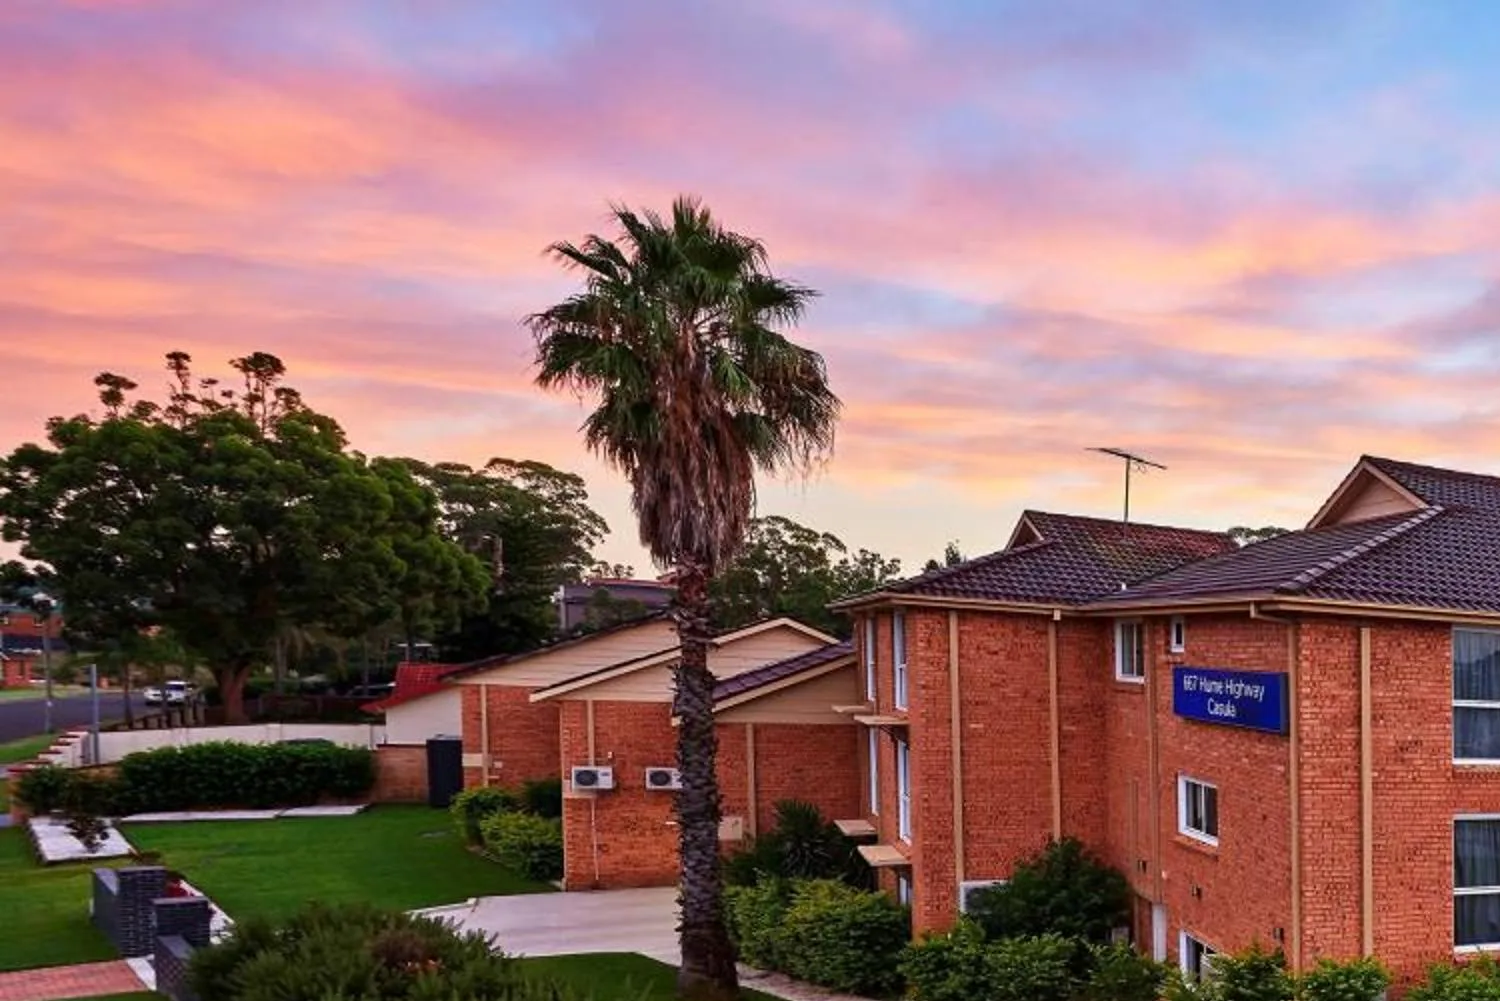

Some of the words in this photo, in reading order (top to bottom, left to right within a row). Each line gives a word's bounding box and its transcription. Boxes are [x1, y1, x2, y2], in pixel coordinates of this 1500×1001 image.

[1200, 677, 1223, 694] Hume
[1226, 679, 1265, 702] Highway
[1207, 698, 1237, 717] Casula
